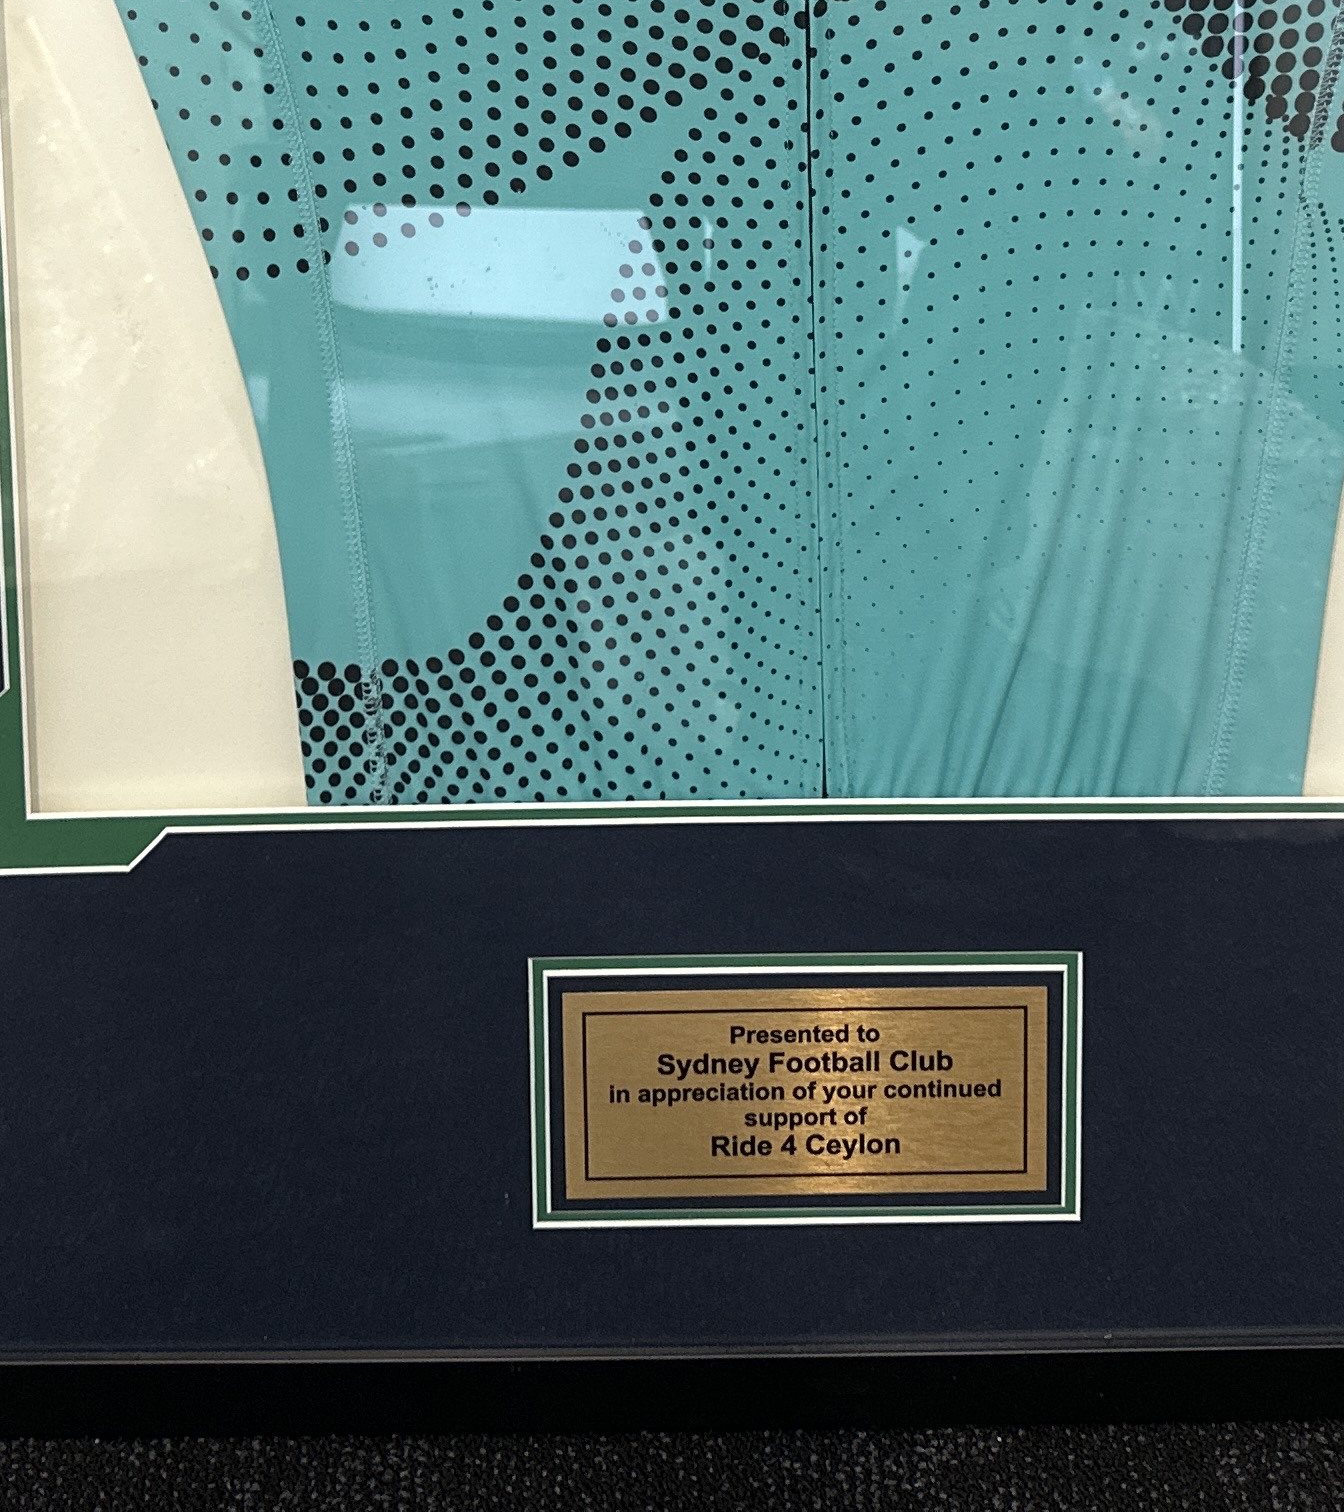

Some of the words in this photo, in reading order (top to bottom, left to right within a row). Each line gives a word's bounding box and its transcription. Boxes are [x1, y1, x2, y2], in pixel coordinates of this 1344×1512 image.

[730, 1024, 850, 1044] Presented
[857, 1024, 881, 1042] to
[657, 1053, 760, 1081] Sydney
[769, 1050, 881, 1073] Football
[889, 1049, 954, 1071] Club
[609, 1085, 631, 1103] in
[637, 1082, 785, 1106] appreciation
[792, 1082, 817, 1100] of
[822, 1083, 877, 1103] your
[883, 1079, 1002, 1098] continued
[744, 1109, 837, 1130] support
[843, 1107, 869, 1125] of
[711, 1135, 773, 1157] Ride
[781, 1135, 797, 1155] 4
[805, 1133, 902, 1160] Ceylon
